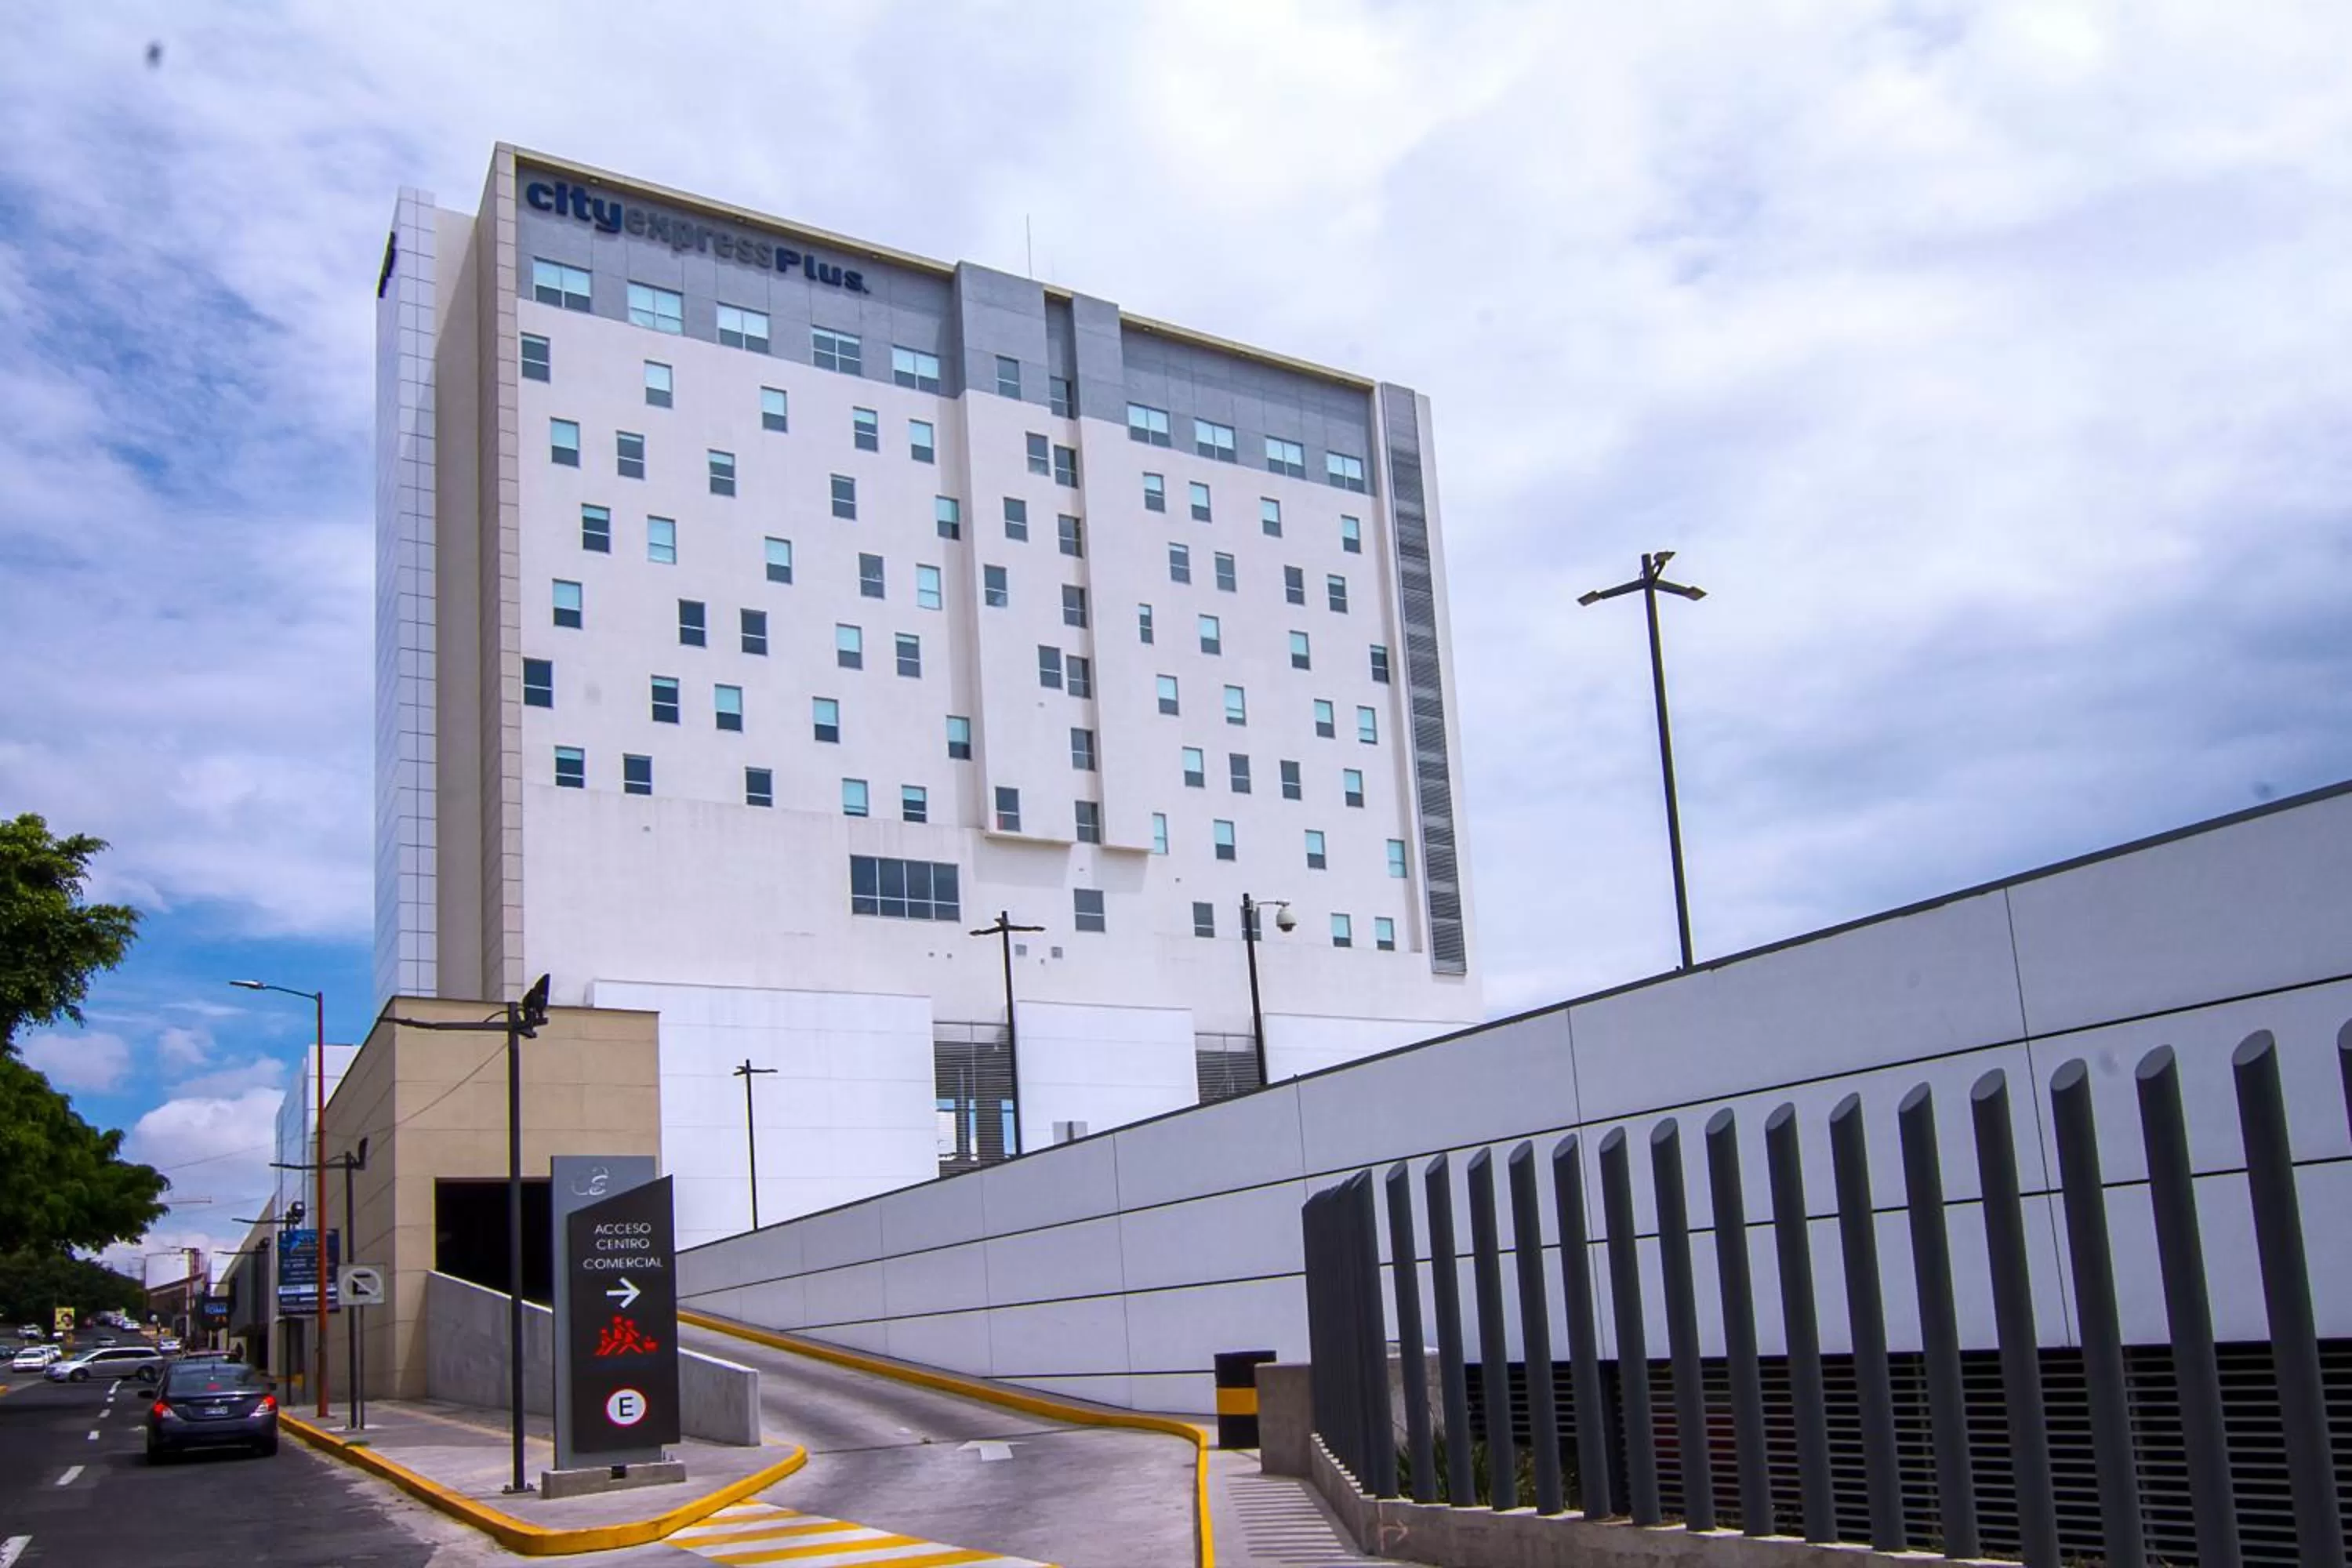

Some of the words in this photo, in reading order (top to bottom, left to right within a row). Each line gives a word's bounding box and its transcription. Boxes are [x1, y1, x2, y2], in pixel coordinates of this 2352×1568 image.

[594, 1222, 652, 1235] ACCESO
[596, 1238, 650, 1250] CENTRO
[583, 1257, 663, 1269] COMERCIAL
[619, 1396, 634, 1417] E
